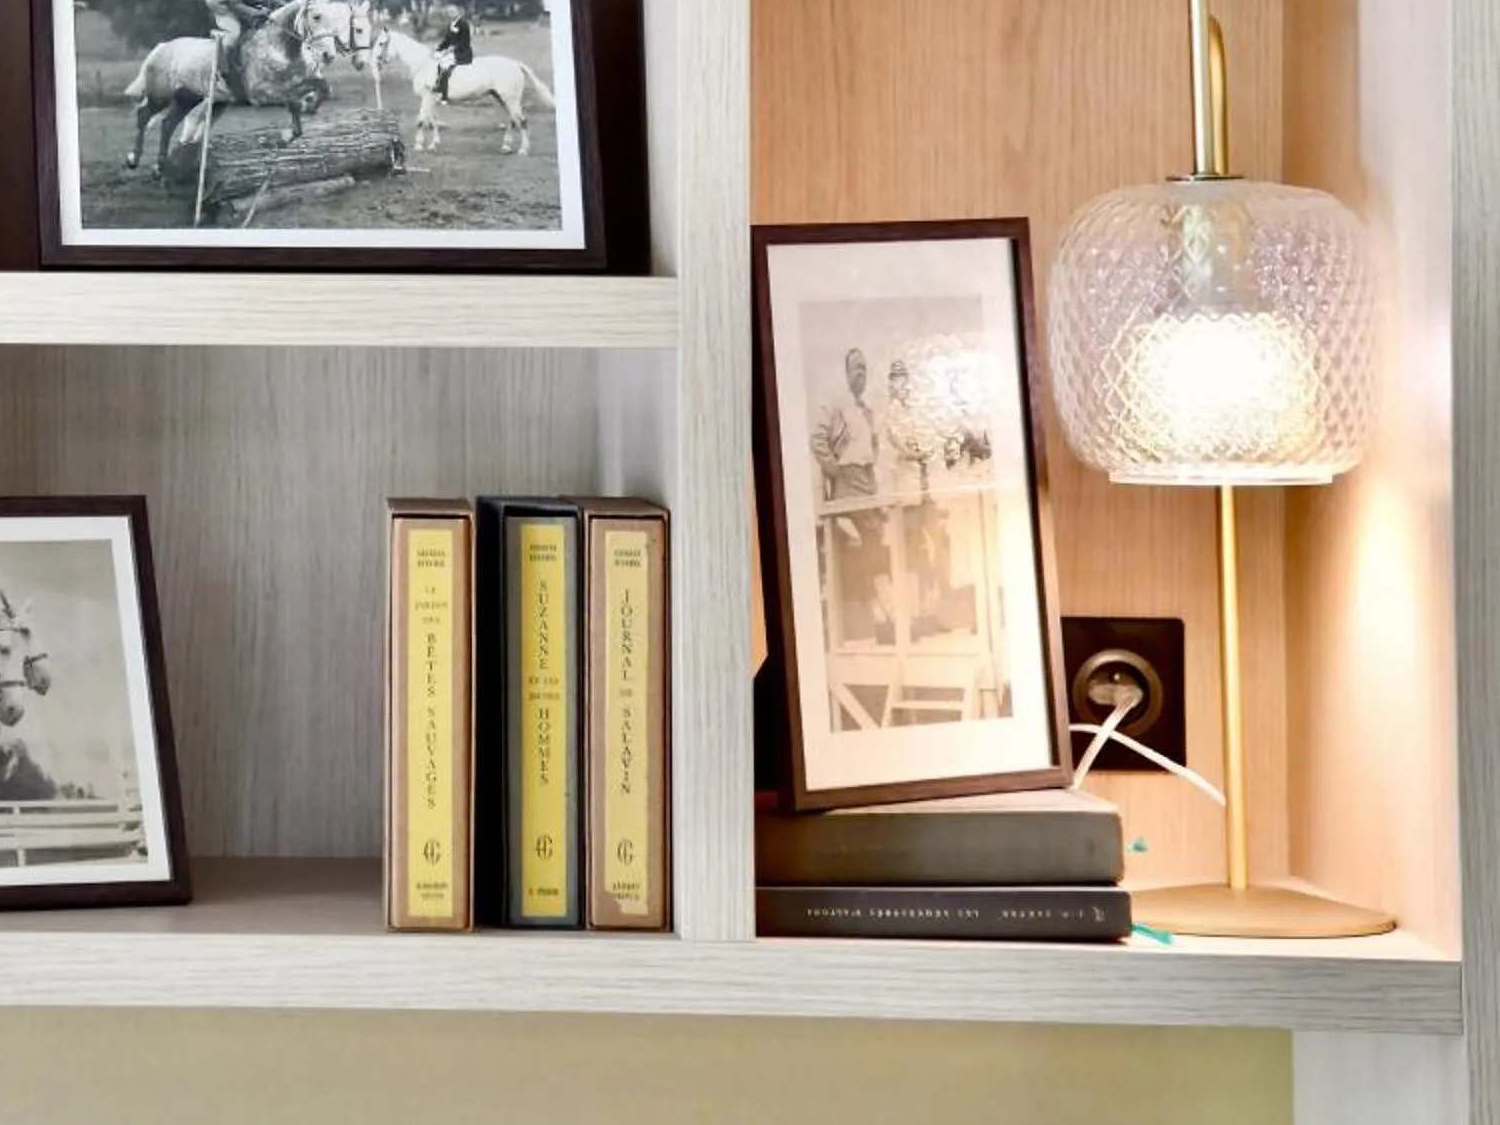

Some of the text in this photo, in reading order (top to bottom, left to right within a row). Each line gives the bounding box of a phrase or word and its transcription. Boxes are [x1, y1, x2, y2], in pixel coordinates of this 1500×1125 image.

[539, 580, 550, 669] SUZANNE
[621, 589, 634, 681] JOURNAL
[426, 707, 437, 810] SAUVAGES
[538, 707, 550, 784] HOMMES
[621, 708, 632, 795] SALAVIN
